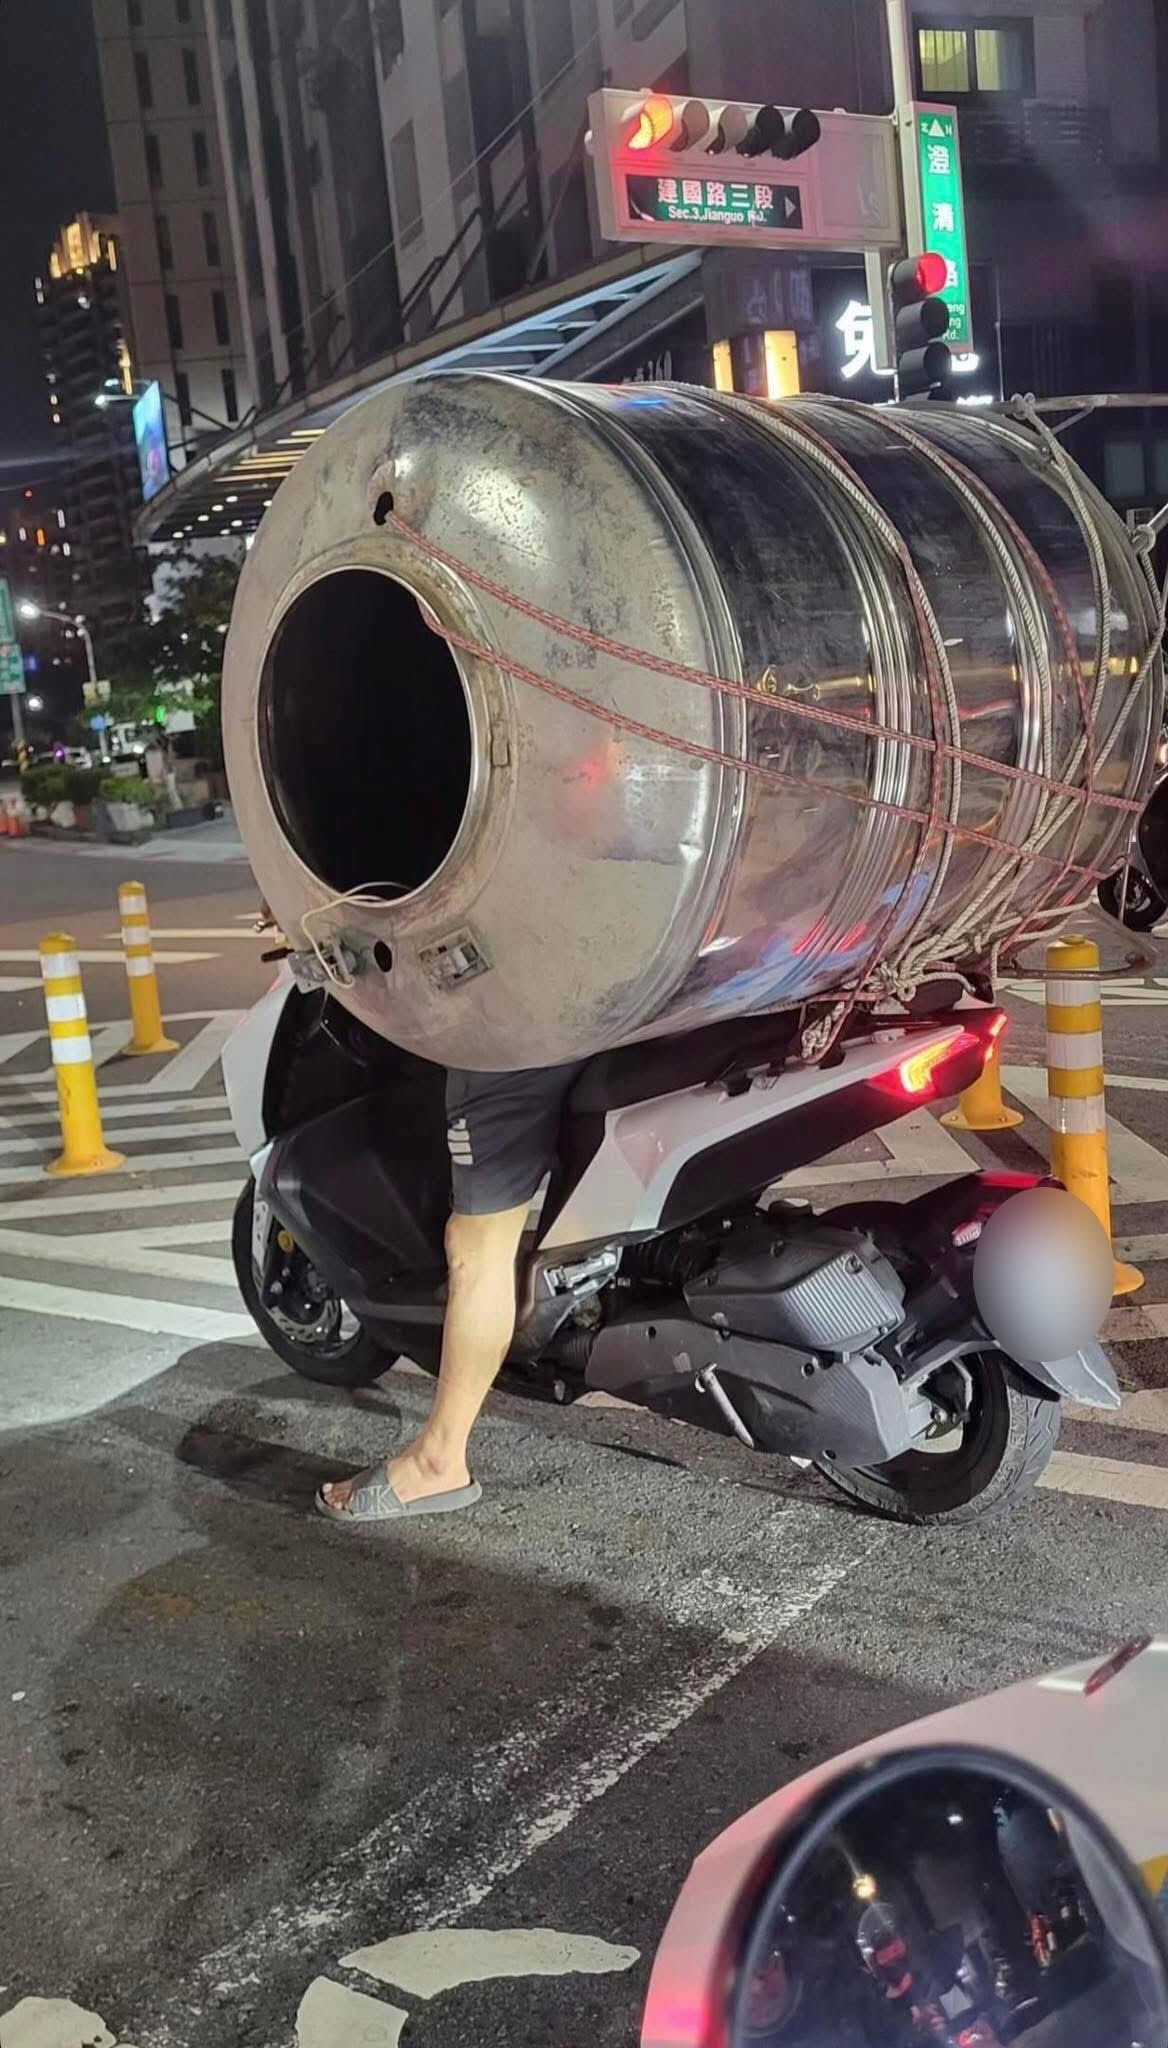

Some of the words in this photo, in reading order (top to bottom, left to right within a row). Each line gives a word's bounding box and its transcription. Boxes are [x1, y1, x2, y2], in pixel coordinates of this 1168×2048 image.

[657, 178, 774, 209] 建國路三段
